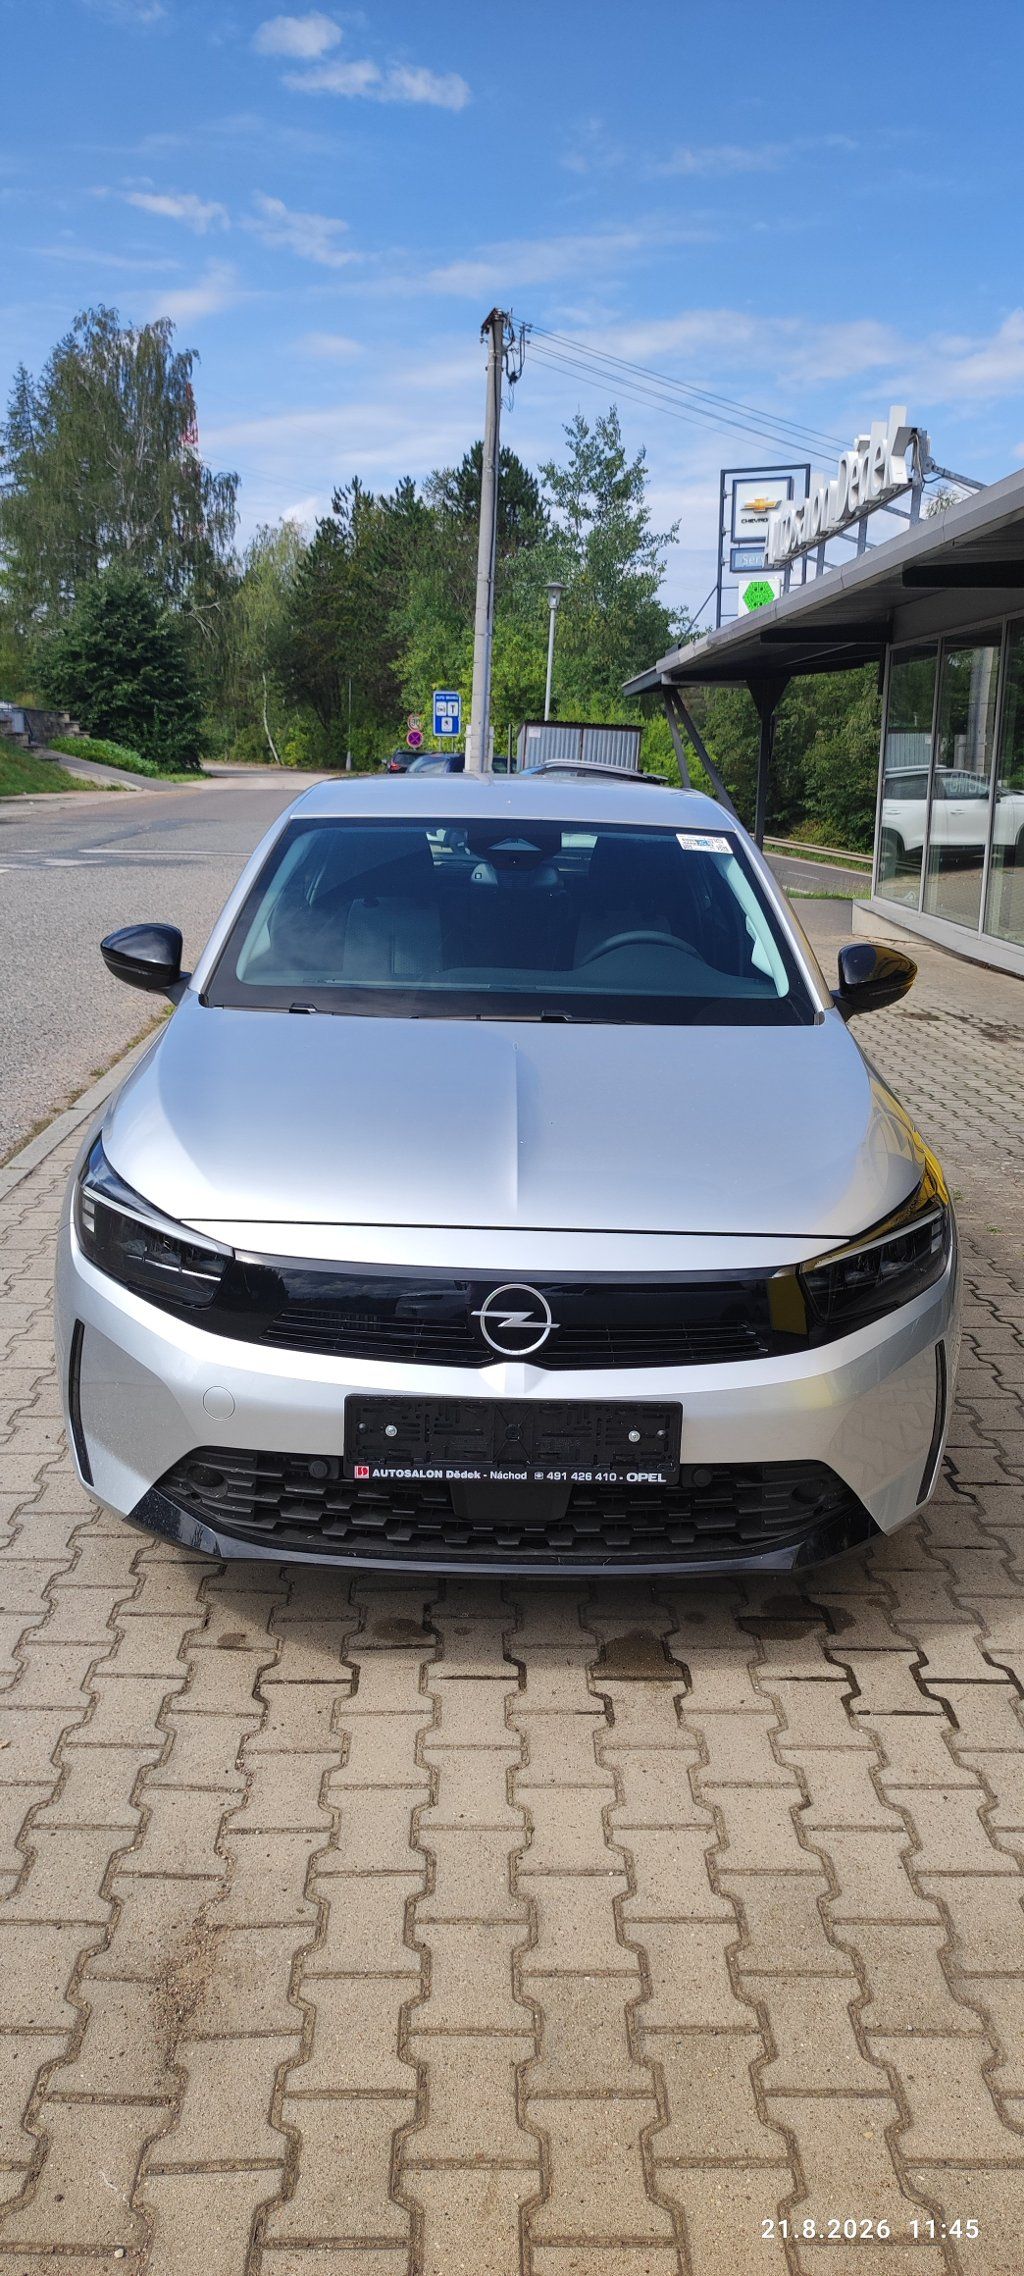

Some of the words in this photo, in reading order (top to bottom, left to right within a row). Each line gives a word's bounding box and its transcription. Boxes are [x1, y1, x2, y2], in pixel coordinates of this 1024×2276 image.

[372, 1468, 443, 1479] AUTOSALON
[446, 1468, 481, 1479] Dědek
[490, 1469, 527, 1480] Náchod
[546, 1472, 567, 1480] 491
[571, 1472, 592, 1481] 426
[595, 1472, 617, 1481] 410
[626, 1472, 667, 1483] OPEL
